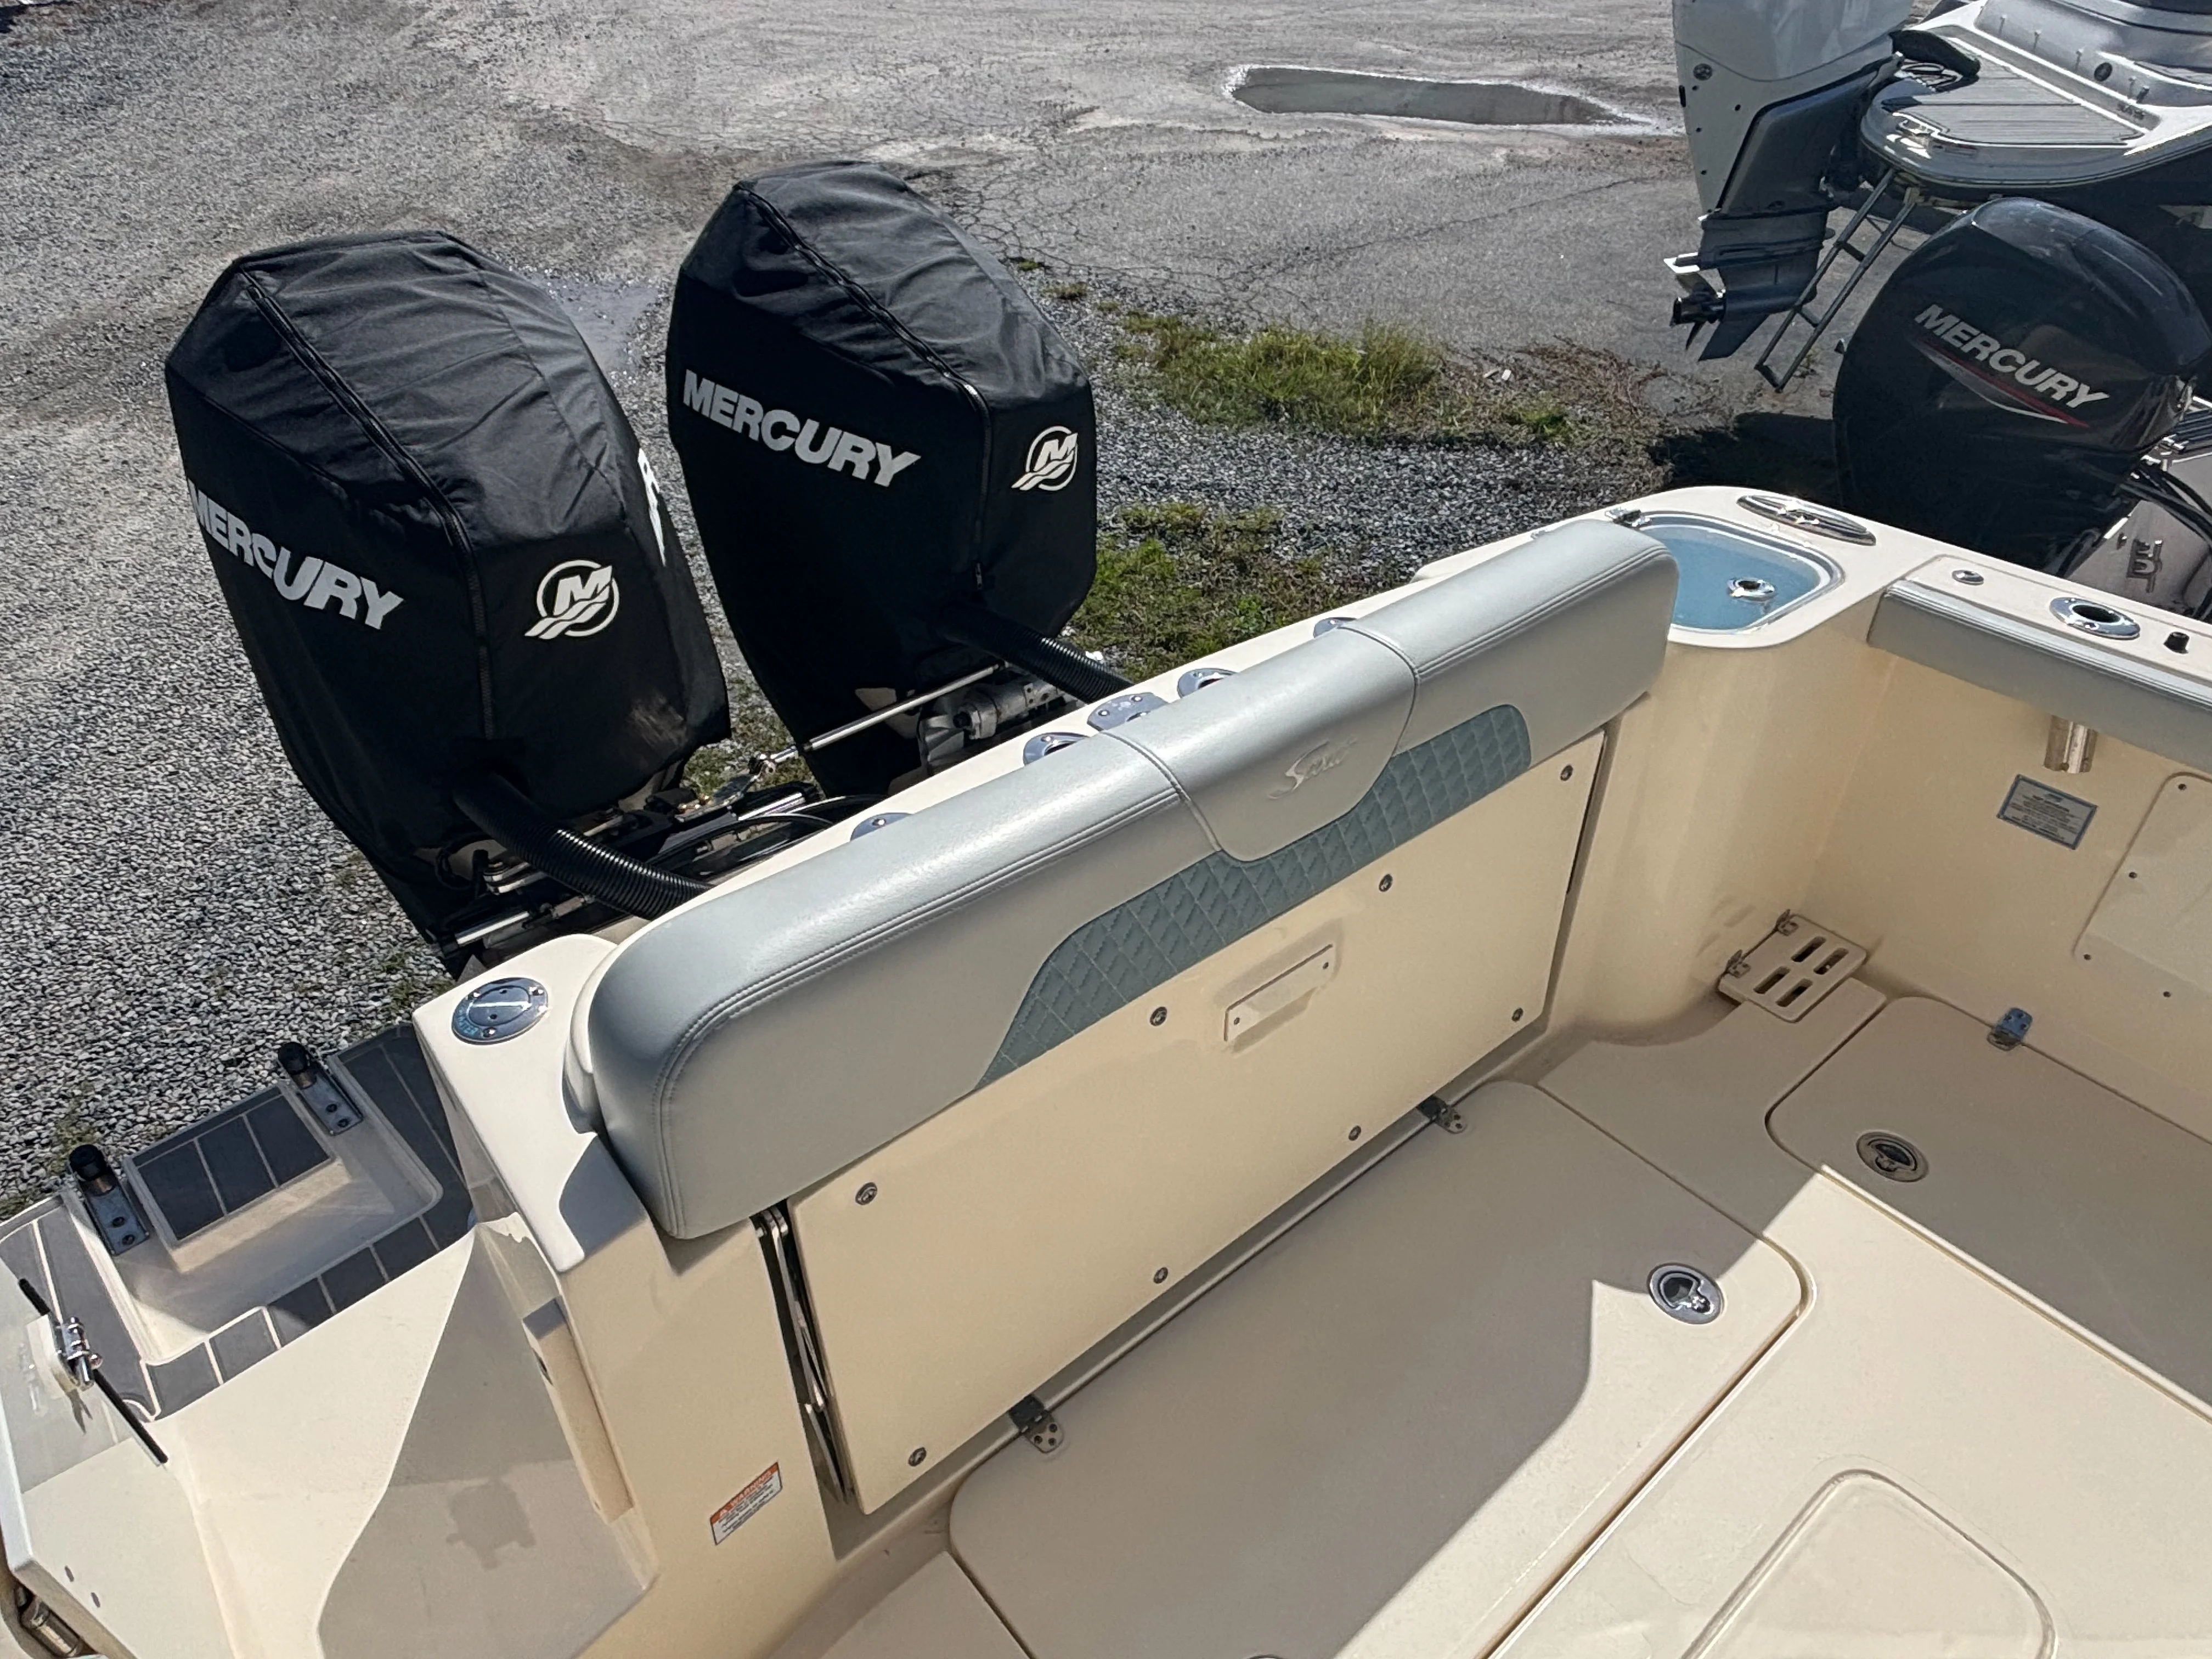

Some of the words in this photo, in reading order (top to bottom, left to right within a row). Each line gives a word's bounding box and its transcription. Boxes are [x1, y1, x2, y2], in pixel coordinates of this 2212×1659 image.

[1915, 304, 2109, 409] MERCURY
[683, 369, 921, 487] MERCURY
[188, 478, 404, 630] MERCURY
